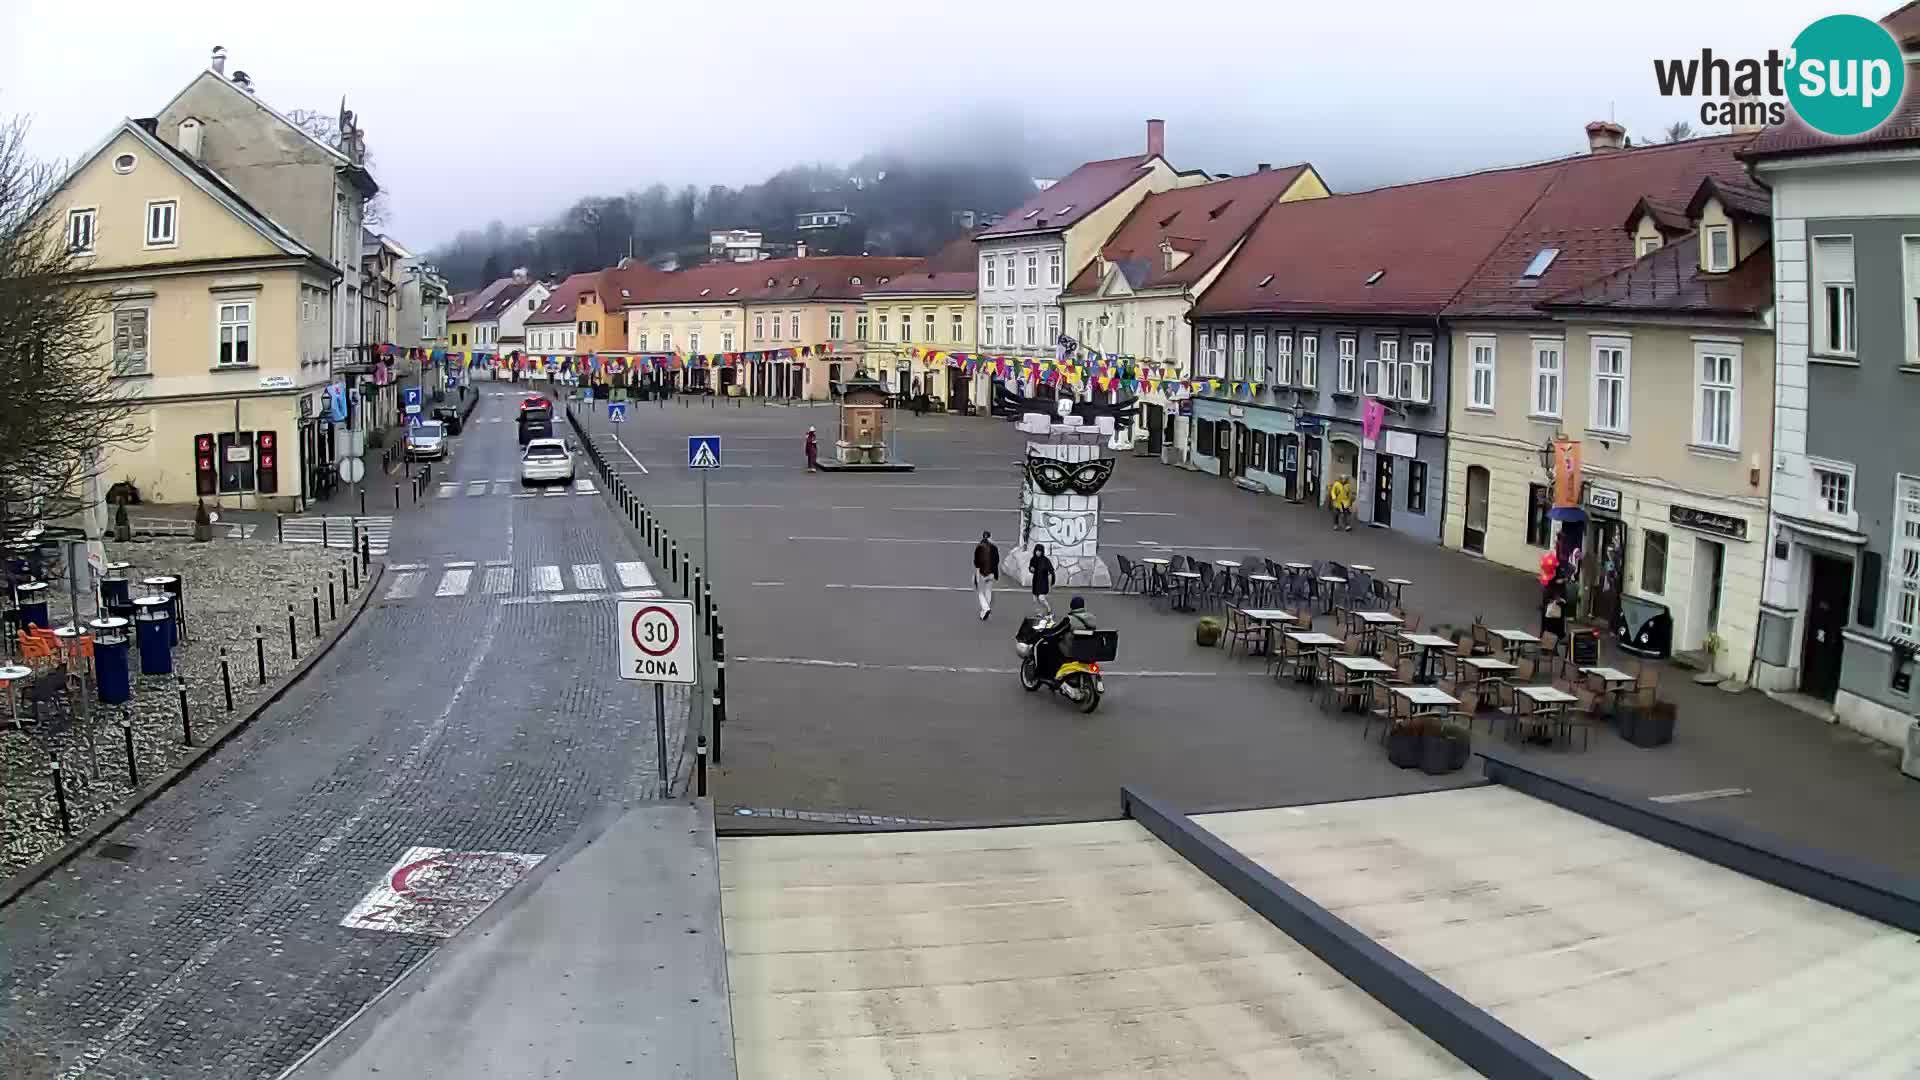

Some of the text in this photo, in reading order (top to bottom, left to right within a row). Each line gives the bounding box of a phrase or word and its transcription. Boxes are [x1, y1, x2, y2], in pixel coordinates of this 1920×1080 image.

[409, 391, 416, 402] P
[1049, 516, 1087, 544] 200
[644, 622, 668, 642] 30
[635, 659, 678, 675] ZONA
